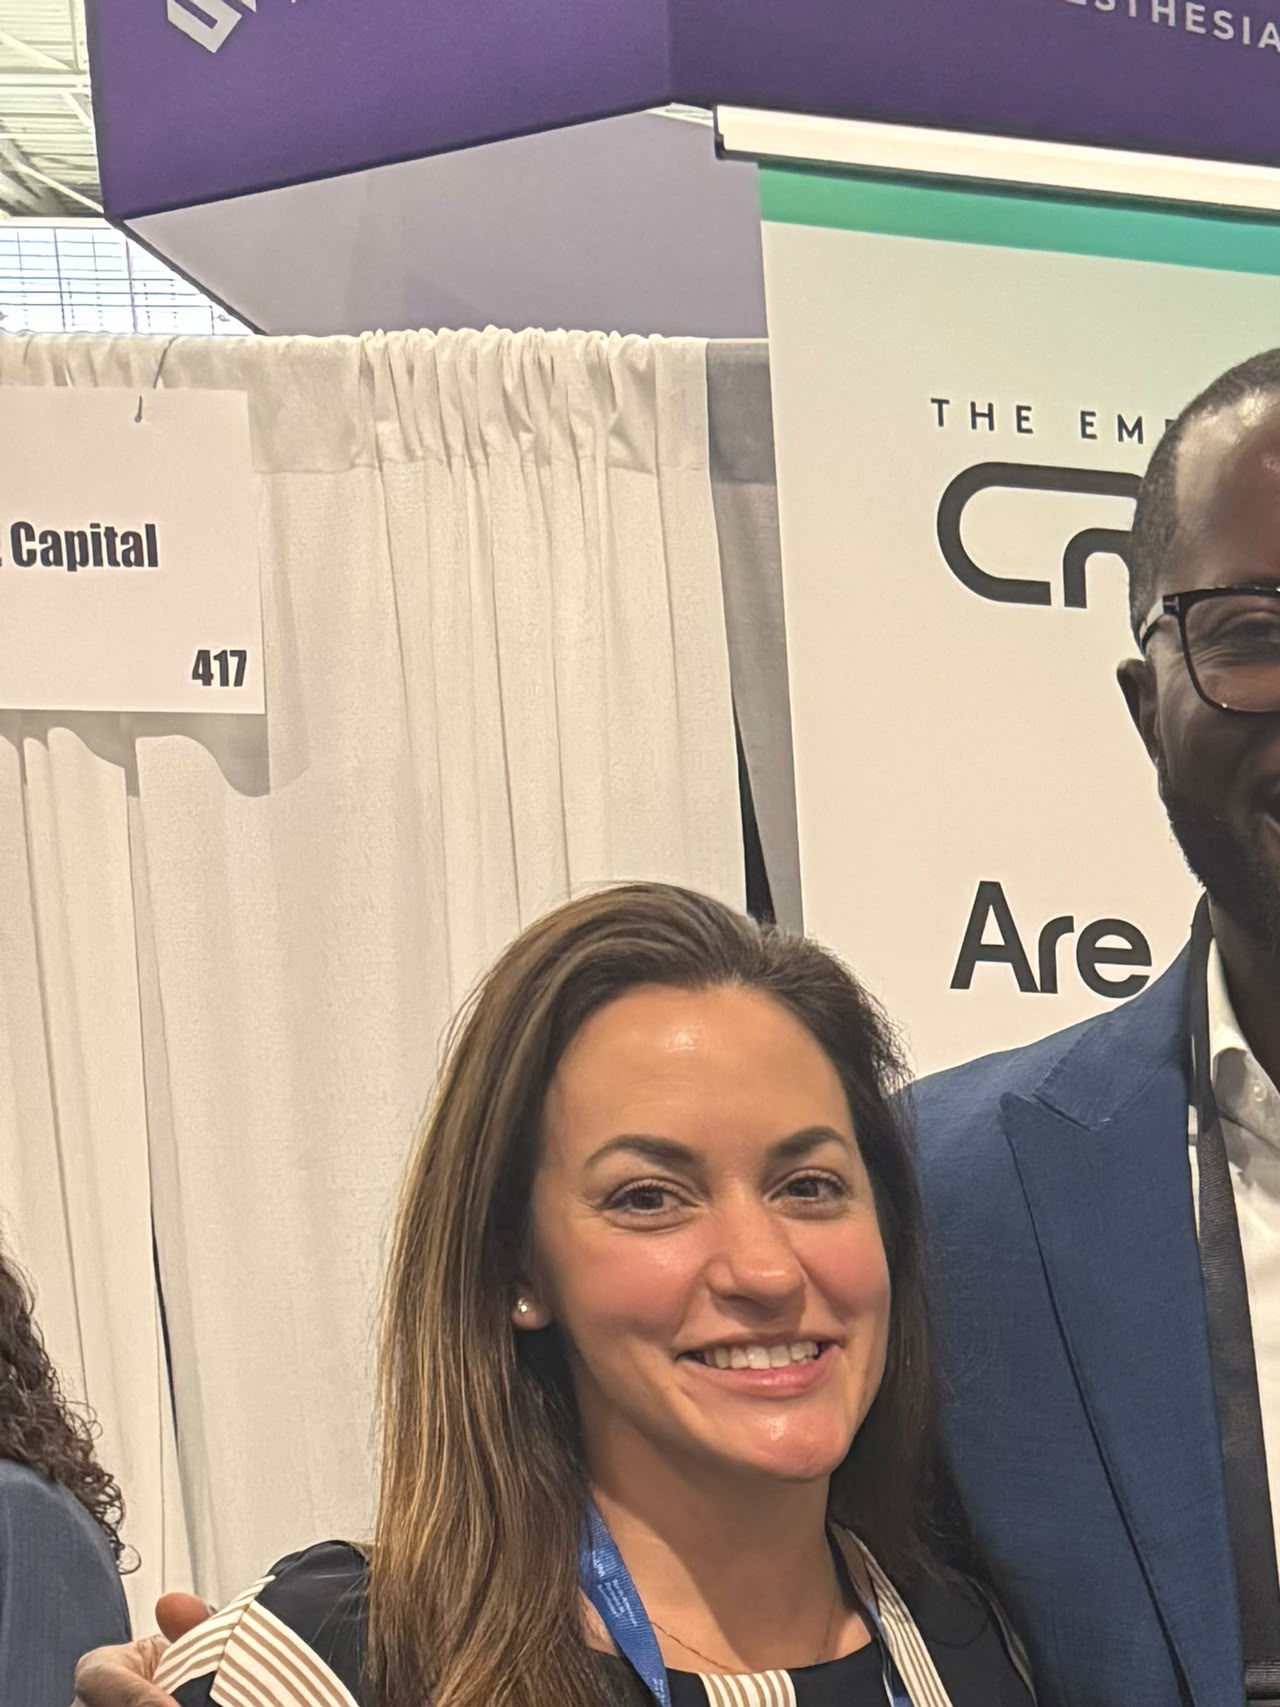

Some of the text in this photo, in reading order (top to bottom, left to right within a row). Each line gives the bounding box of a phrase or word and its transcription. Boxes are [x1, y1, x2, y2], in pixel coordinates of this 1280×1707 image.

[930, 398, 1177, 445] THE EM
[10, 521, 159, 572] Capital
[191, 649, 247, 687] 417
[950, 880, 1152, 999] Are
